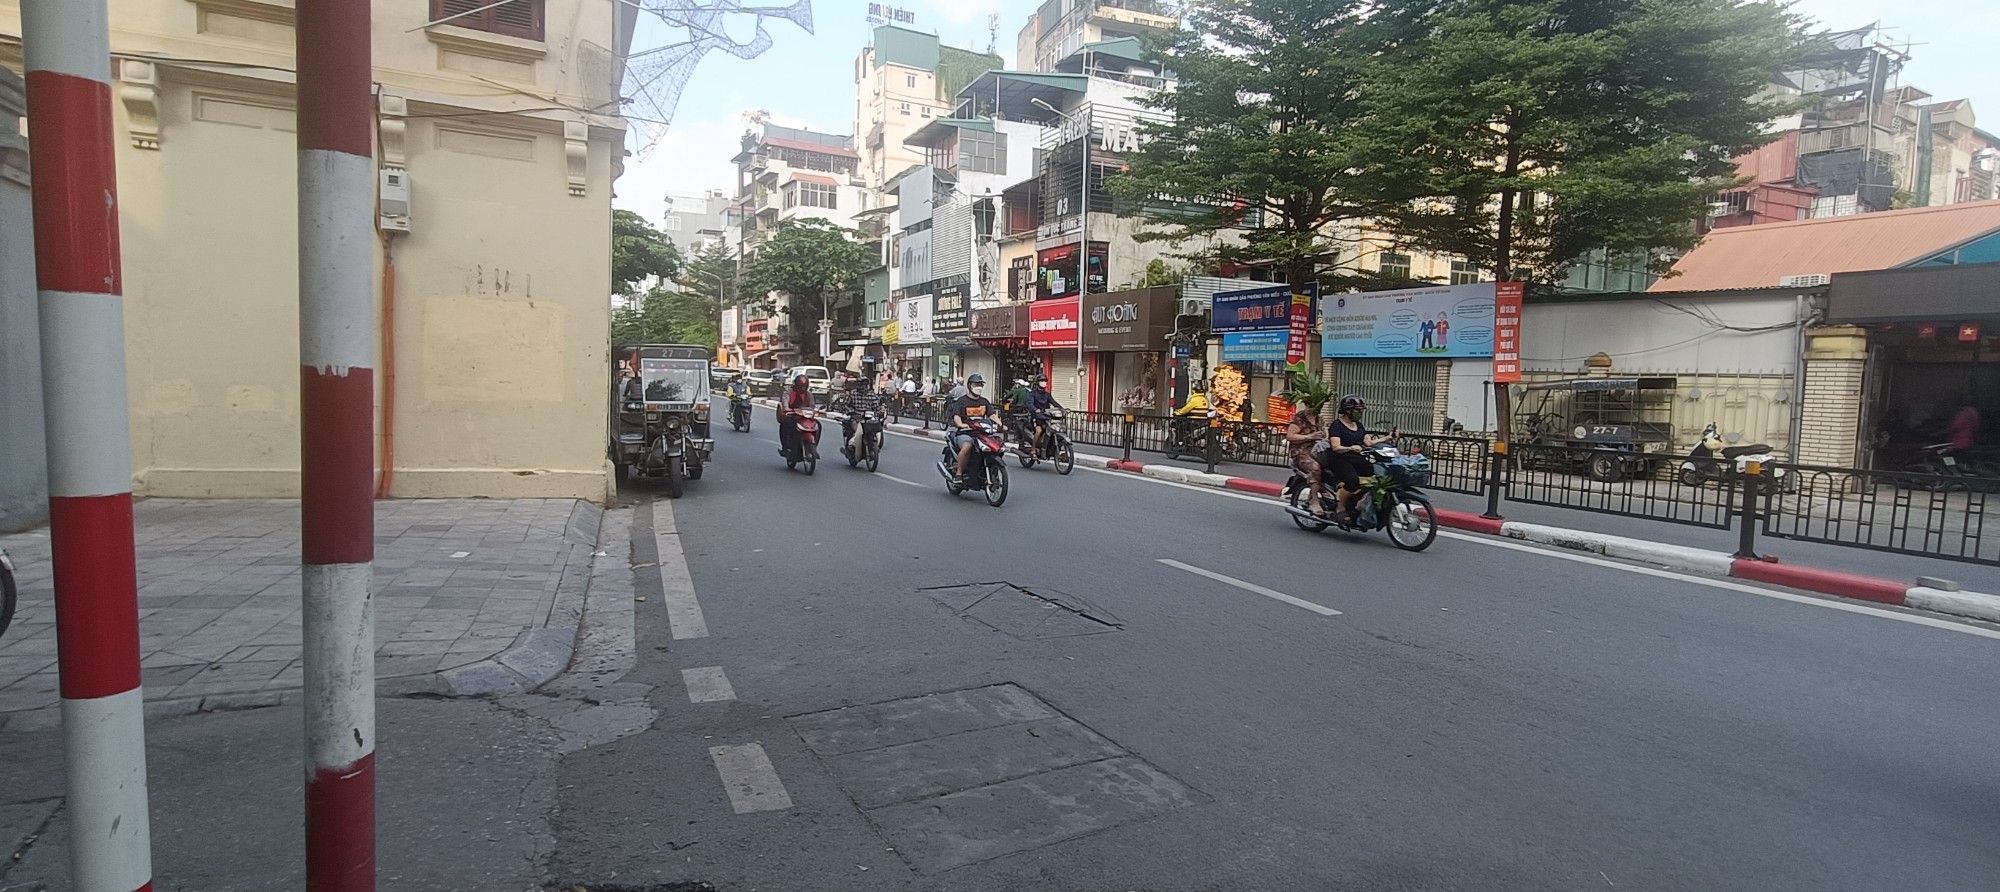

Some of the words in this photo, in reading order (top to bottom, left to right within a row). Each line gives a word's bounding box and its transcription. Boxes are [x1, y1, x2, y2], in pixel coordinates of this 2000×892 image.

[1238, 306, 1262, 322] TRẠM
[1265, 305, 1271, 318] Y
[1273, 301, 1285, 318] TẾ
[662, 349, 673, 358] 27
[687, 349, 692, 358] 7
[1592, 426, 1618, 434] 27-7
